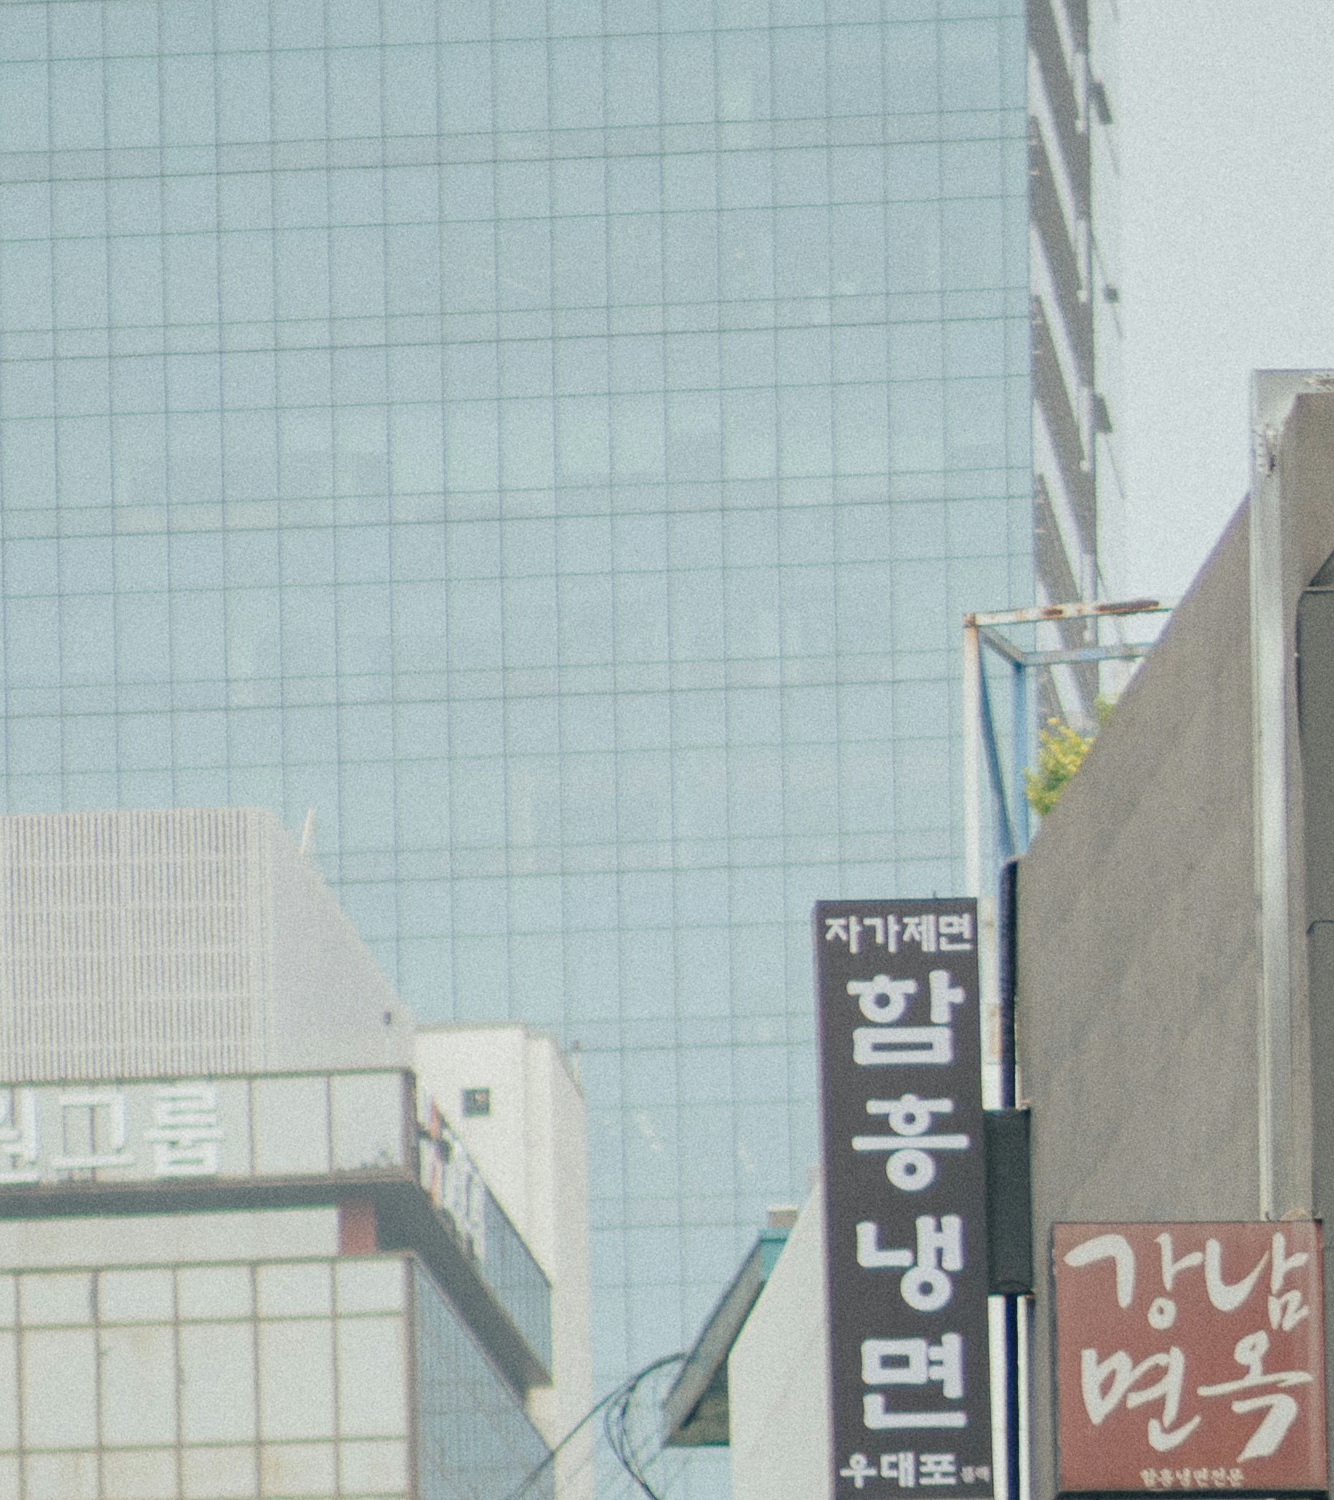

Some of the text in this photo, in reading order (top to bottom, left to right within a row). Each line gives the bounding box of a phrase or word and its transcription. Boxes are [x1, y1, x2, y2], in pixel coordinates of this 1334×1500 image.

[824, 914, 974, 953] 자가제면
[846, 969, 969, 1429] 함흥냉면
[1065, 1232, 1310, 1332] 강남
[1081, 1329, 1314, 1462] 면옥
[839, 1452, 958, 1489] 우대포
